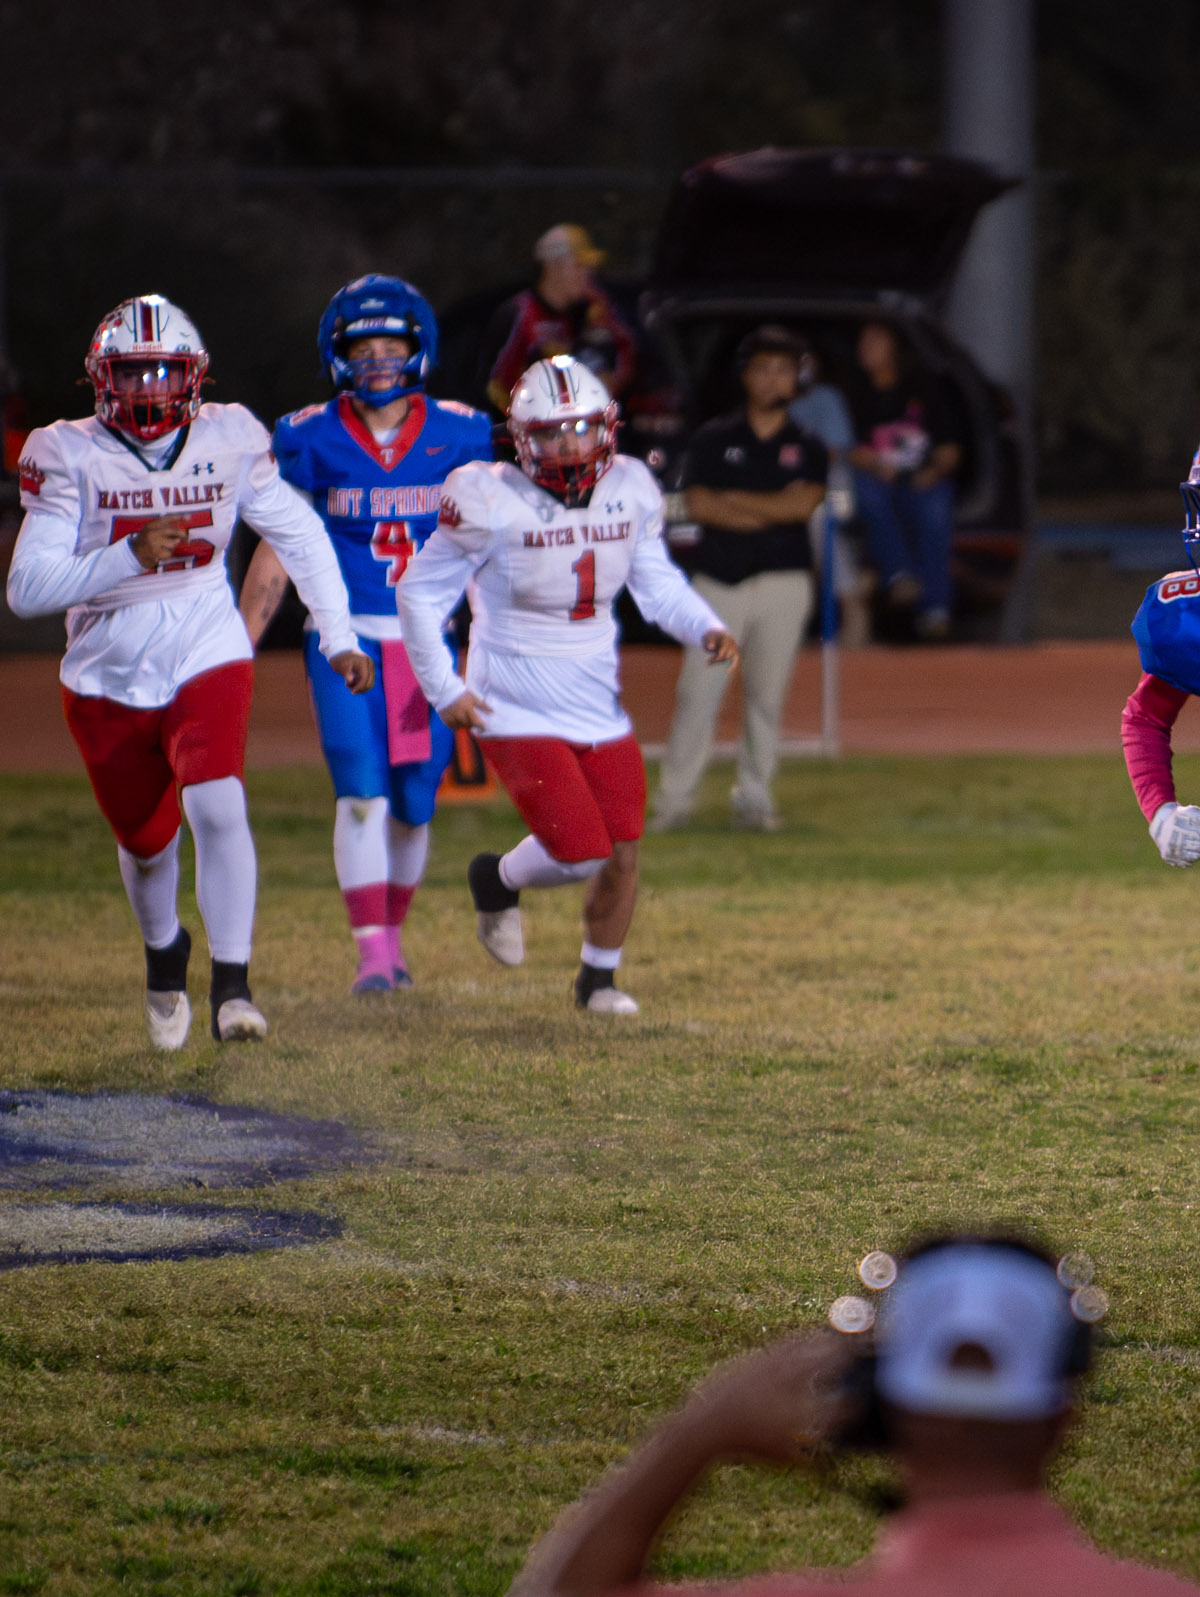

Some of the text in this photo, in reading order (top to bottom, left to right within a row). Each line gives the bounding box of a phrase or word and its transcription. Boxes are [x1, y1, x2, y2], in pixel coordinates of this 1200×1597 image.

[380, 448, 394, 465] T
[99, 482, 224, 510] HATCH VALLEY
[328, 484, 442, 517] HOT SPRING
[523, 525, 575, 548] HATCH
[370, 520, 418, 588] 4
[568, 548, 596, 623] 1
